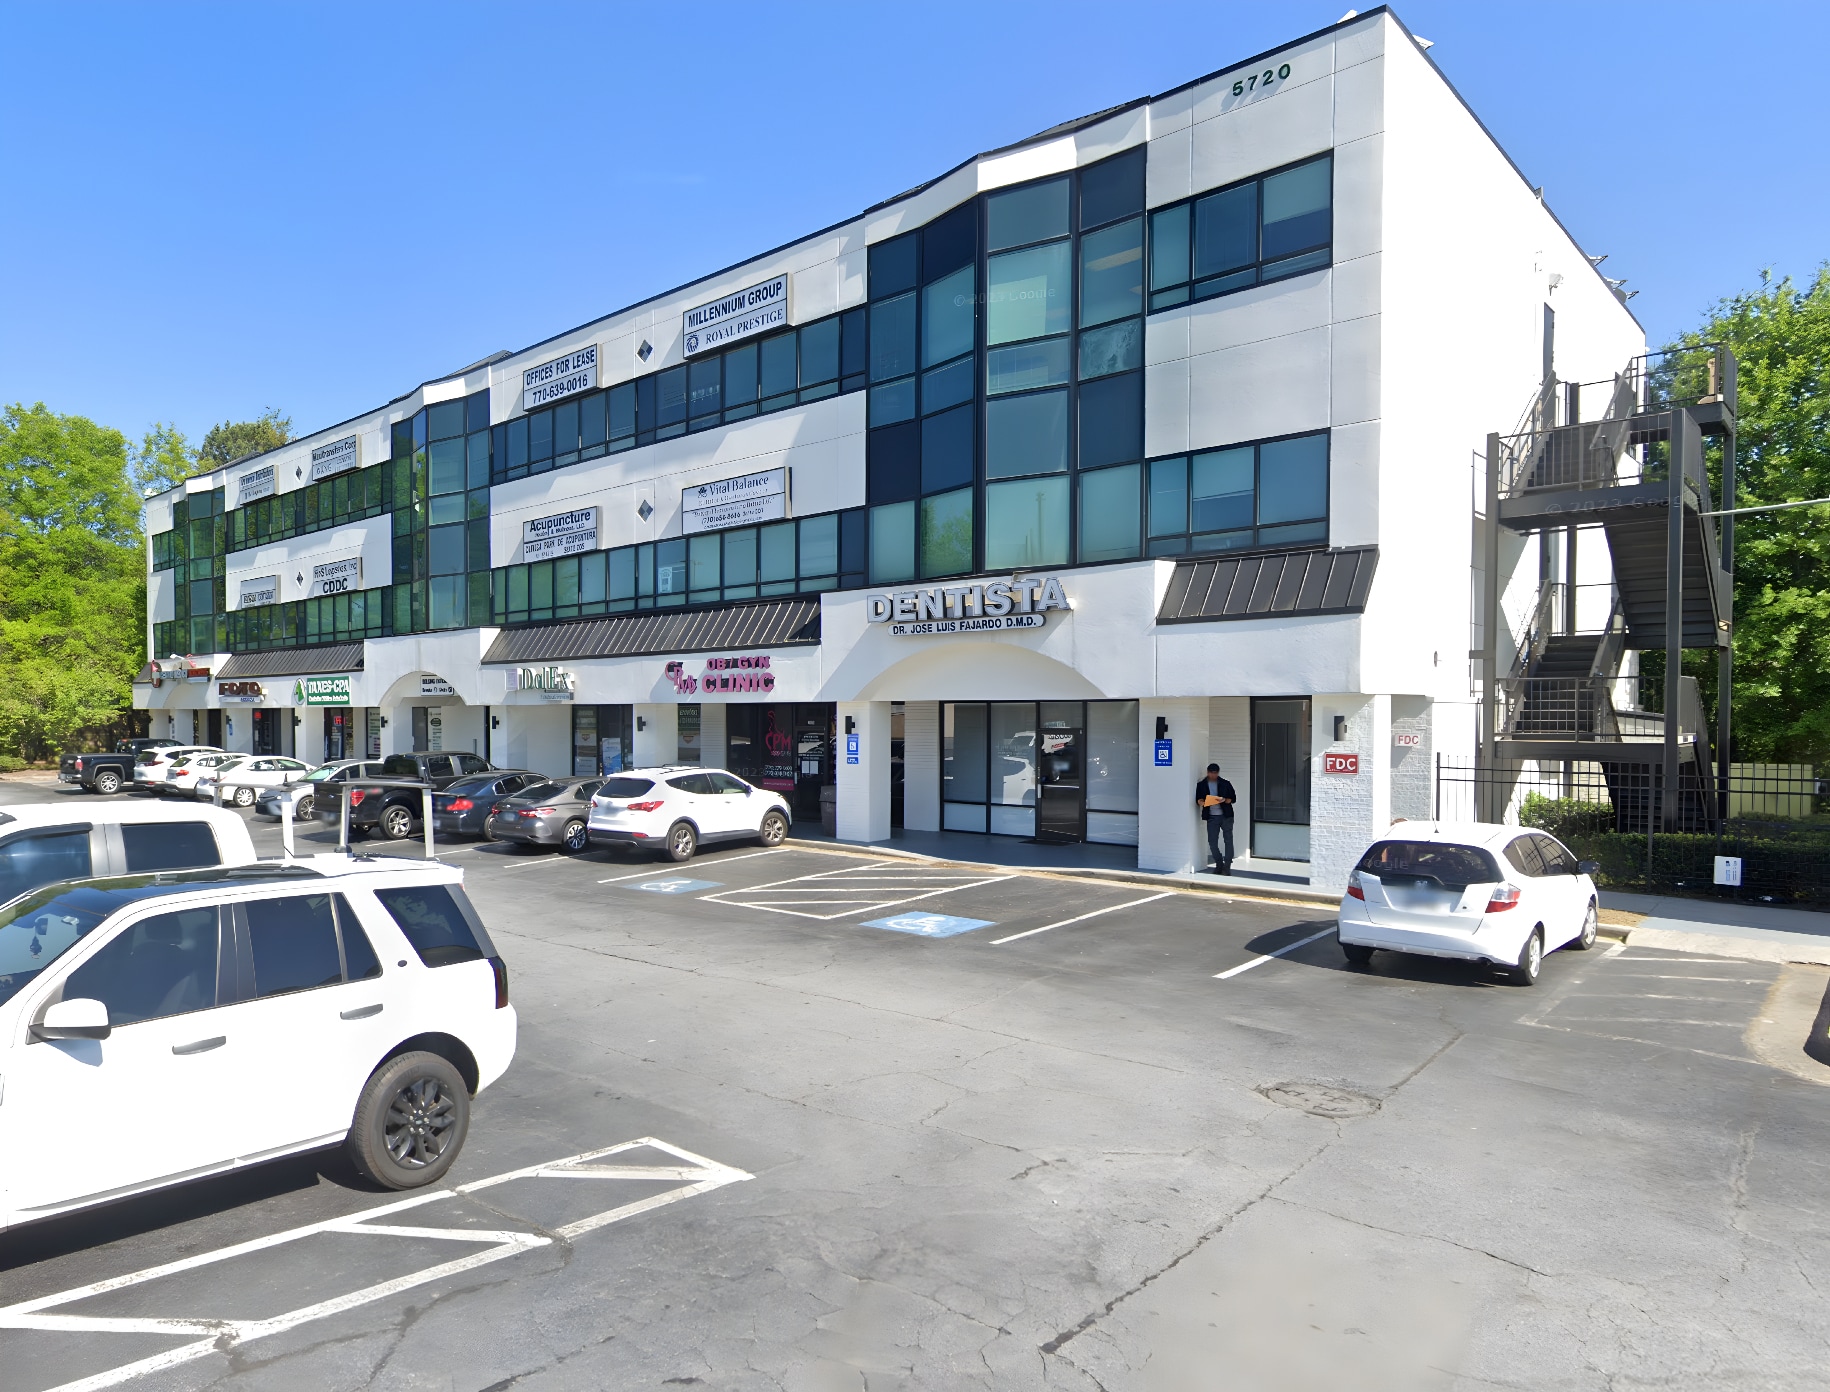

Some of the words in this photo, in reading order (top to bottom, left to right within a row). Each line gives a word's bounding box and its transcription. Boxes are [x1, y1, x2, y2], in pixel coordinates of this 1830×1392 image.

[1233, 63, 1291, 97] 5720
[688, 294, 746, 328] MILLENNIUM
[748, 281, 782, 306] GROUP
[705, 325, 735, 345] ROYAL
[737, 308, 783, 334] PRESTIGE
[526, 364, 553, 386] OFFICES
[556, 358, 570, 375] FOR
[572, 348, 595, 370] LEASE
[532, 373, 588, 404] 770-639-0016
[709, 481, 730, 496] Vital
[732, 476, 769, 491] Balance
[529, 511, 591, 536] Acupuncture
[322, 577, 348, 594] CDDC
[866, 576, 1071, 623] DENTISTA
[893, 624, 907, 635] DR.
[910, 622, 933, 634] JOSE
[936, 621, 956, 633] LUIS
[959, 617, 1002, 631] FAJARDO
[1006, 615, 1037, 628] D.M.D.
[706, 657, 727, 671] OB
[738, 655, 771, 670] GYN
[702, 672, 775, 694] CLINIC
[1398, 735, 1419, 745] FDC
[1326, 757, 1357, 771] FDC
